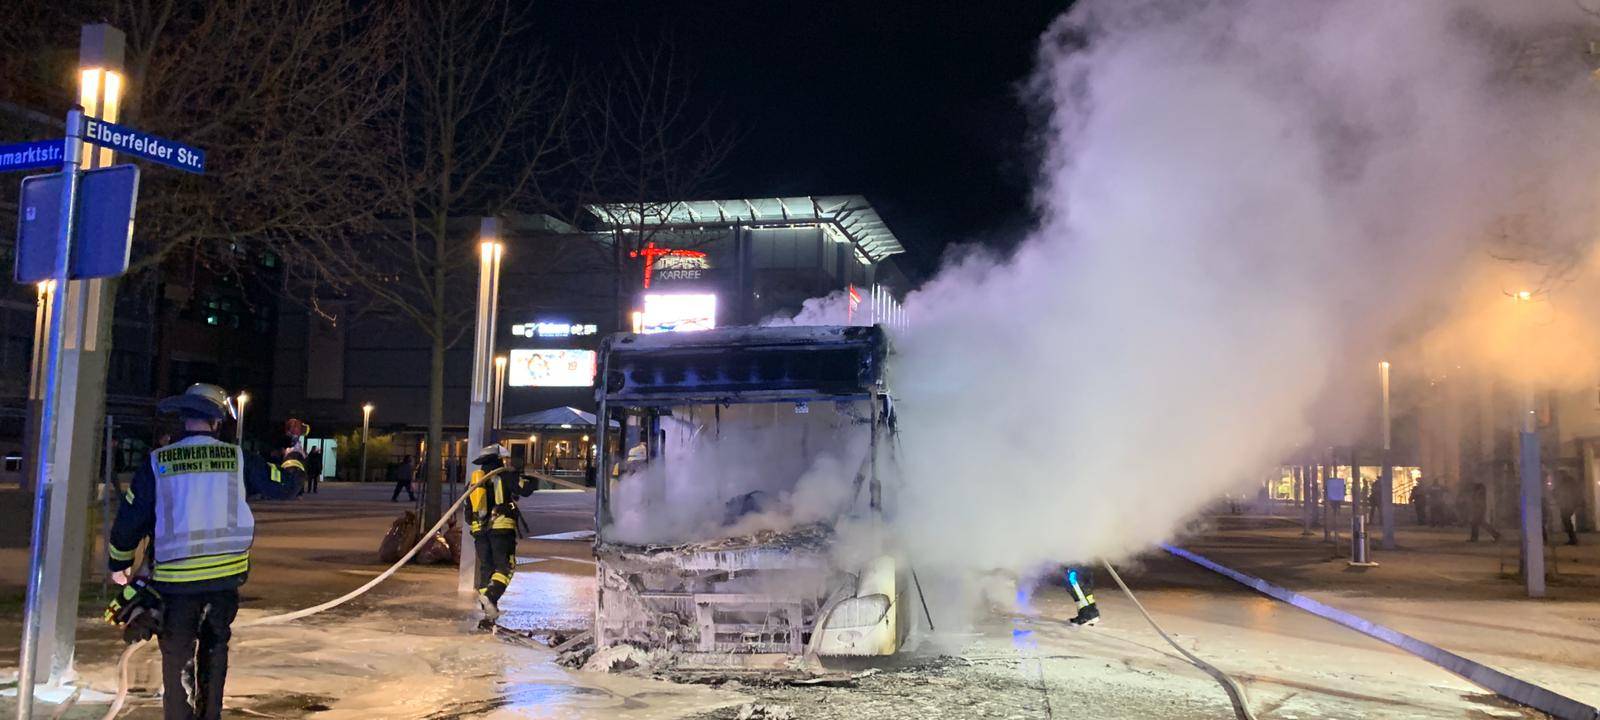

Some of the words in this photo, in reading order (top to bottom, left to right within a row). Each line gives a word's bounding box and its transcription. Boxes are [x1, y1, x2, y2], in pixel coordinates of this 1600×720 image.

[86, 120, 173, 160] Elberfelder
[177, 147, 202, 168] Str.
[660, 269, 702, 280] KARREE
[208, 446, 236, 459] HAGEN
[172, 462, 203, 473] DIENST
[210, 460, 235, 470] MITTE
